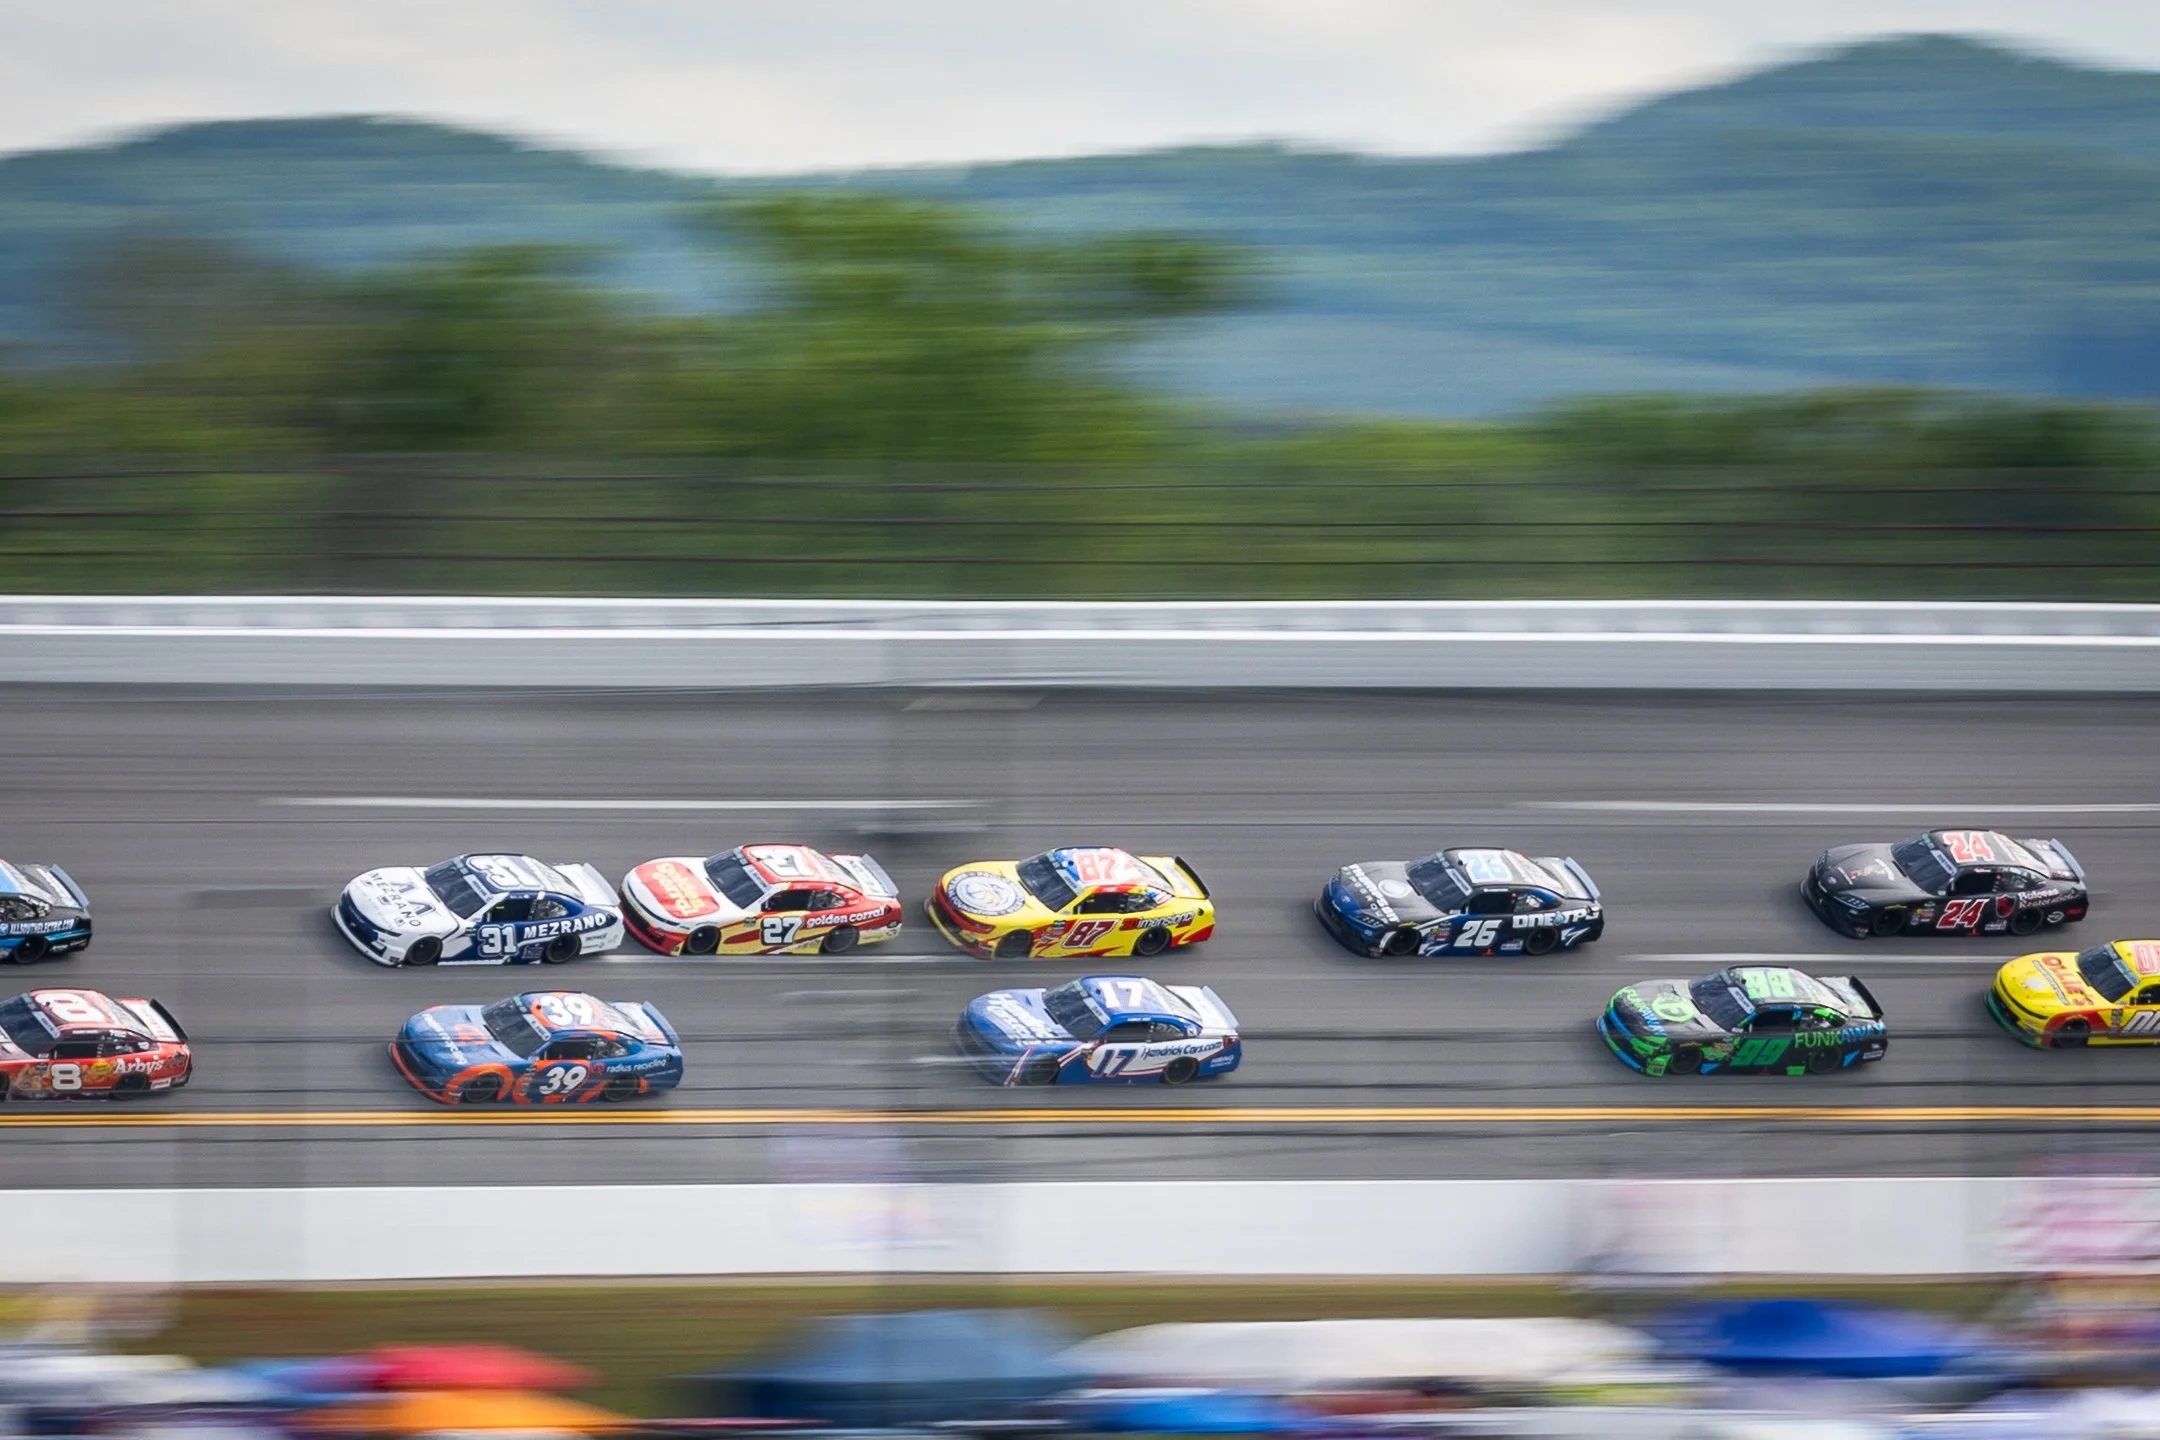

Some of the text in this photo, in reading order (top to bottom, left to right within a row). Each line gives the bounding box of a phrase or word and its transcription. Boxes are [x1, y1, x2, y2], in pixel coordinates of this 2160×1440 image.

[1942, 832, 1994, 863] 24
[466, 855, 544, 890] 31
[1074, 851, 1117, 883] 87
[523, 912, 606, 939] MEZRANO
[806, 907, 885, 929] golden corral
[1936, 899, 1990, 929] 24
[478, 924, 519, 956] 31
[761, 916, 803, 945] 27
[1061, 918, 1121, 948] 87
[1453, 919, 1503, 947] 26
[34, 992, 106, 1023] 8
[1098, 980, 1144, 1008] 17
[539, 994, 593, 1026] 39
[115, 1055, 165, 1074] Arby's
[1091, 1048, 1139, 1078] 17
[1730, 1038, 1792, 1066] 99
[51, 1063, 82, 1091] 8
[539, 1065, 587, 1095] 39
[606, 1063, 632, 1074] radius
